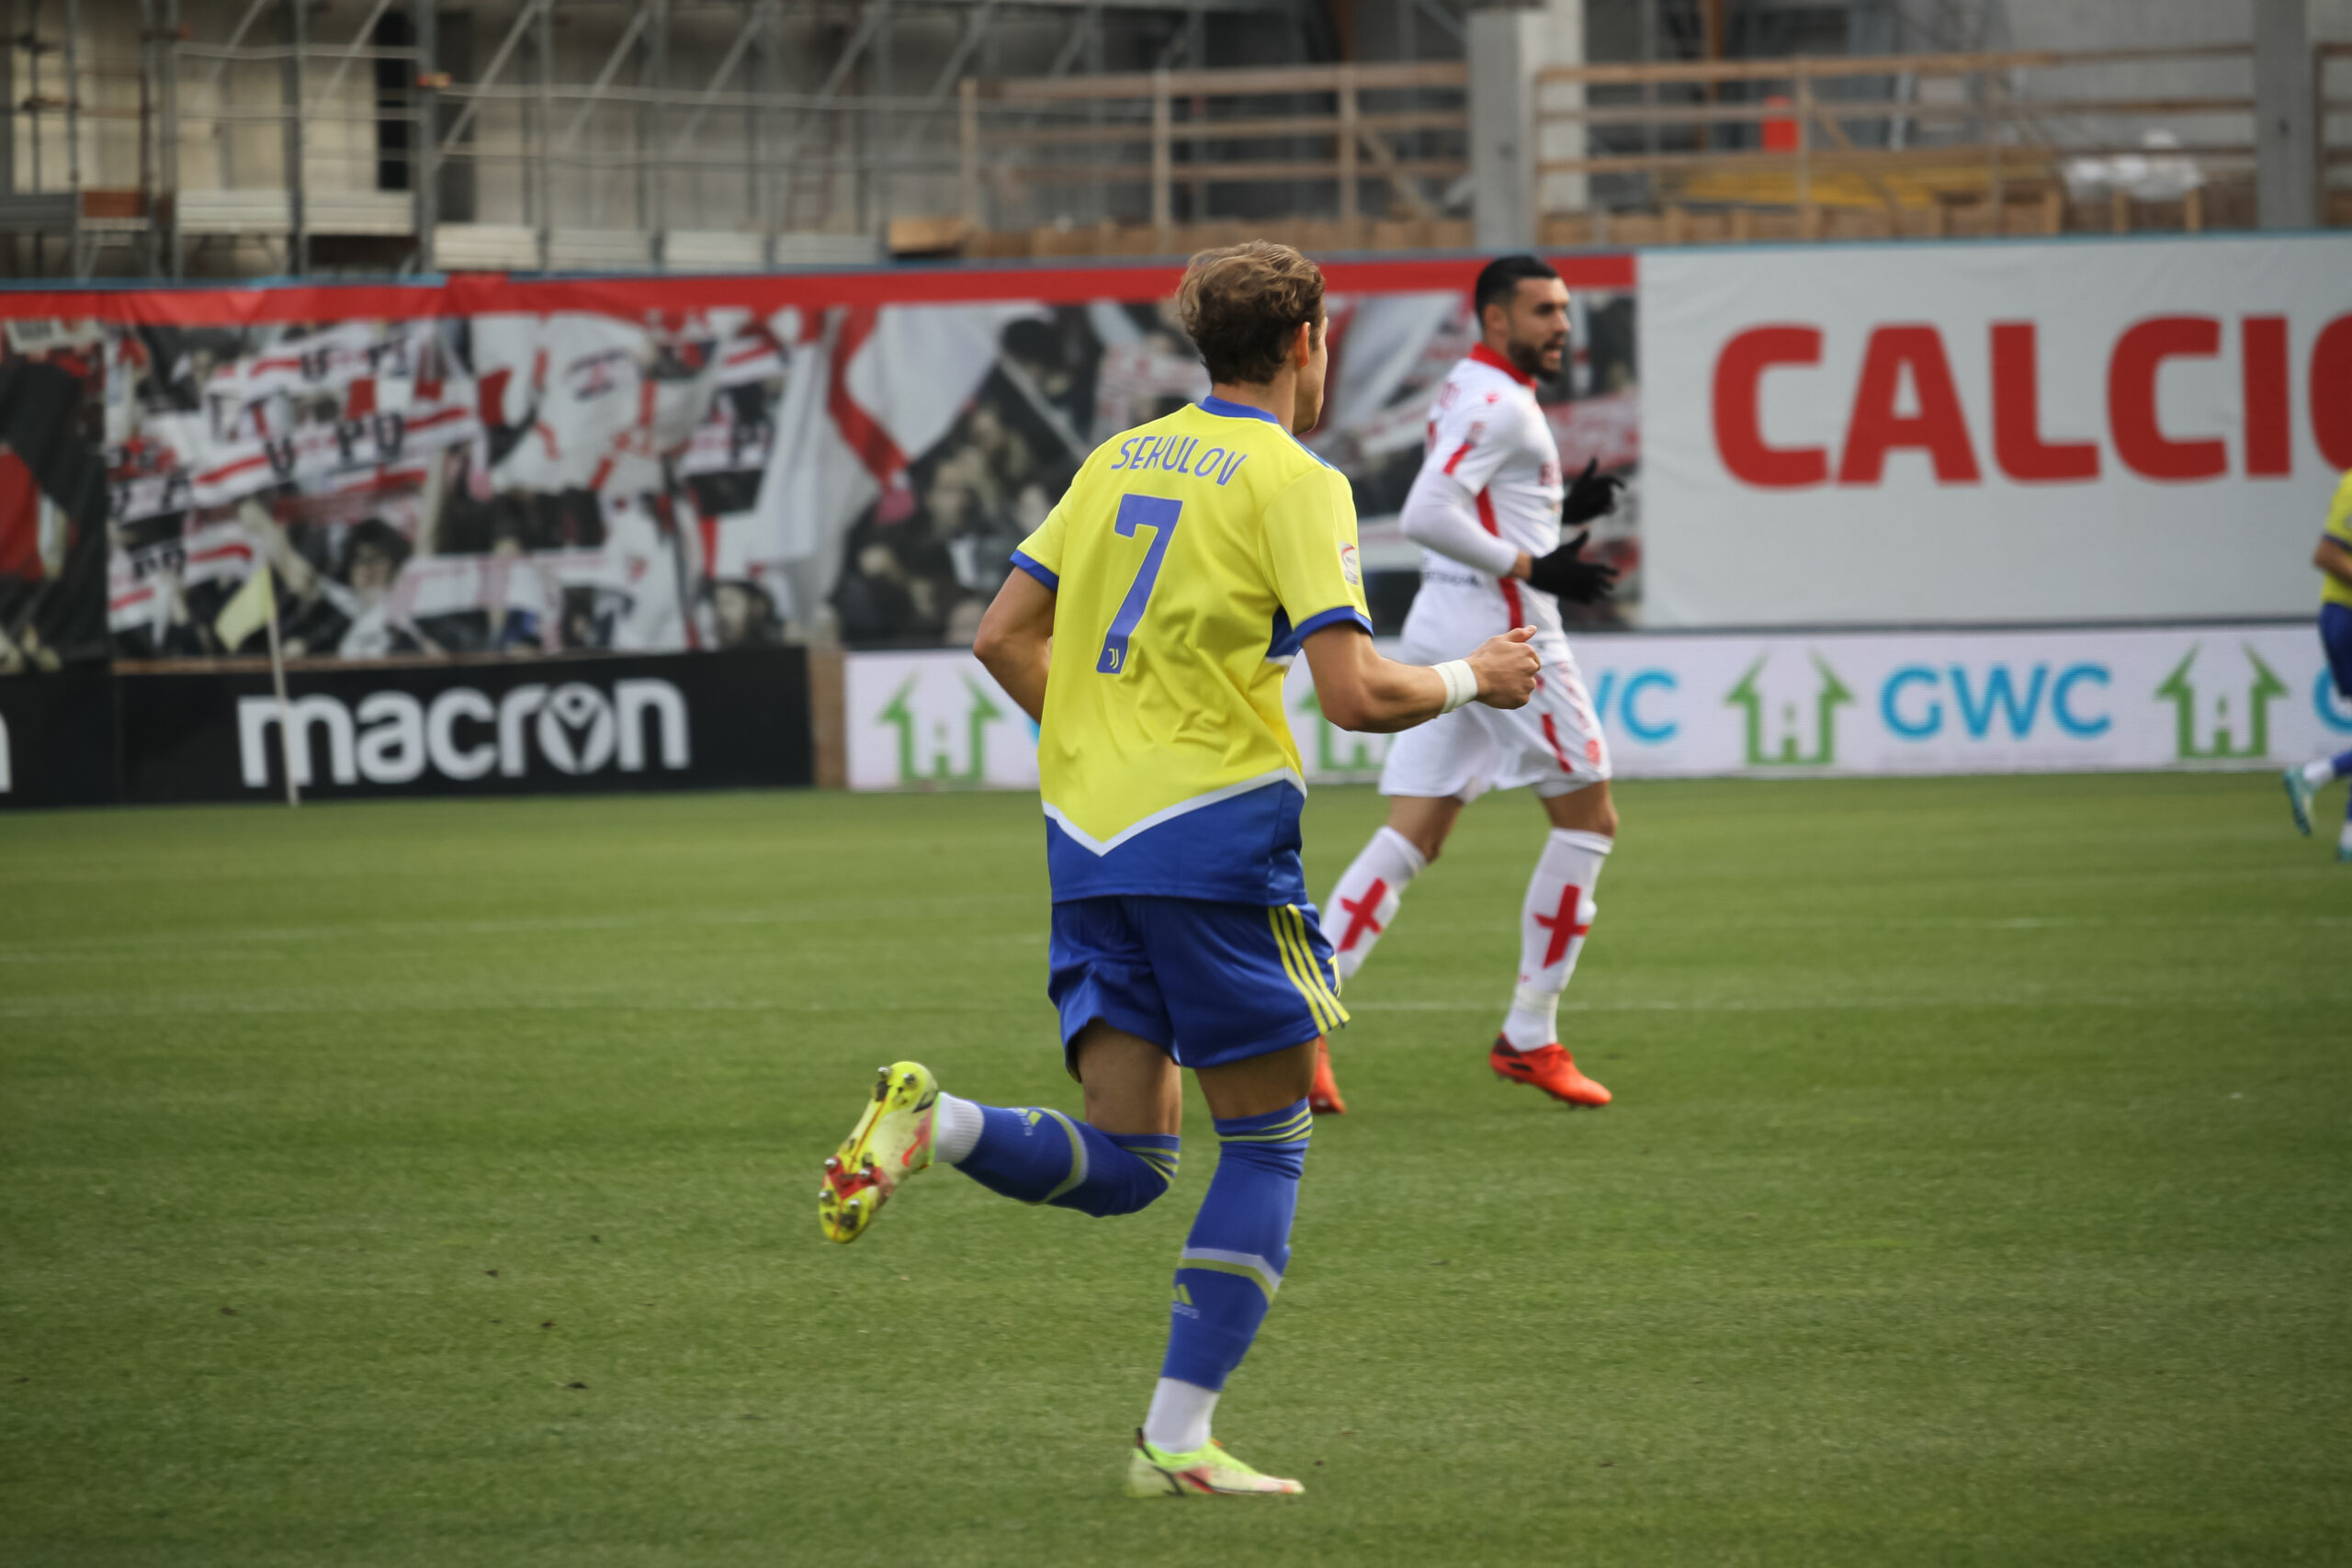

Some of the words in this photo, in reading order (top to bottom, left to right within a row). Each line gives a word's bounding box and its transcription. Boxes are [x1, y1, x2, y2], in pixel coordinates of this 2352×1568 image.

[1111, 434, 1248, 486] SEKULOV
[1096, 493, 1183, 674] 7
[237, 678, 691, 788] macron
[1879, 662, 2112, 740] GWC
